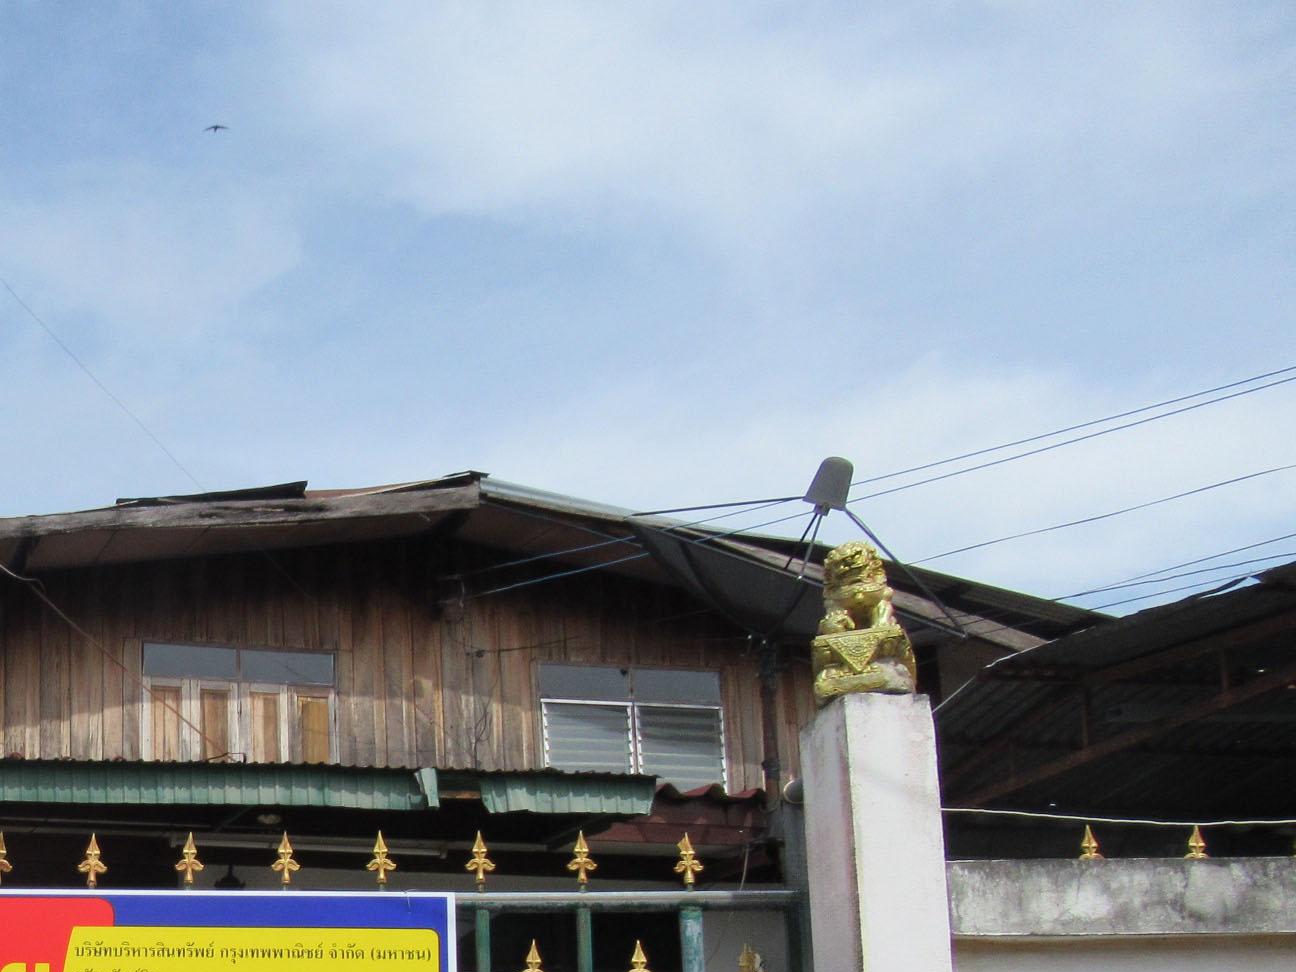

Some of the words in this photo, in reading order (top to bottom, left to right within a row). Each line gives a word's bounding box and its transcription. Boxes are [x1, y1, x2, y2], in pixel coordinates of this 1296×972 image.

[74, 941, 215, 958] บริษัทบริหารสินทรัพย์
[220, 941, 324, 964] กรุงเทพพาณิชย์
[329, 943, 365, 960] จำกัด
[370, 947, 432, 962] (มหาชน)
